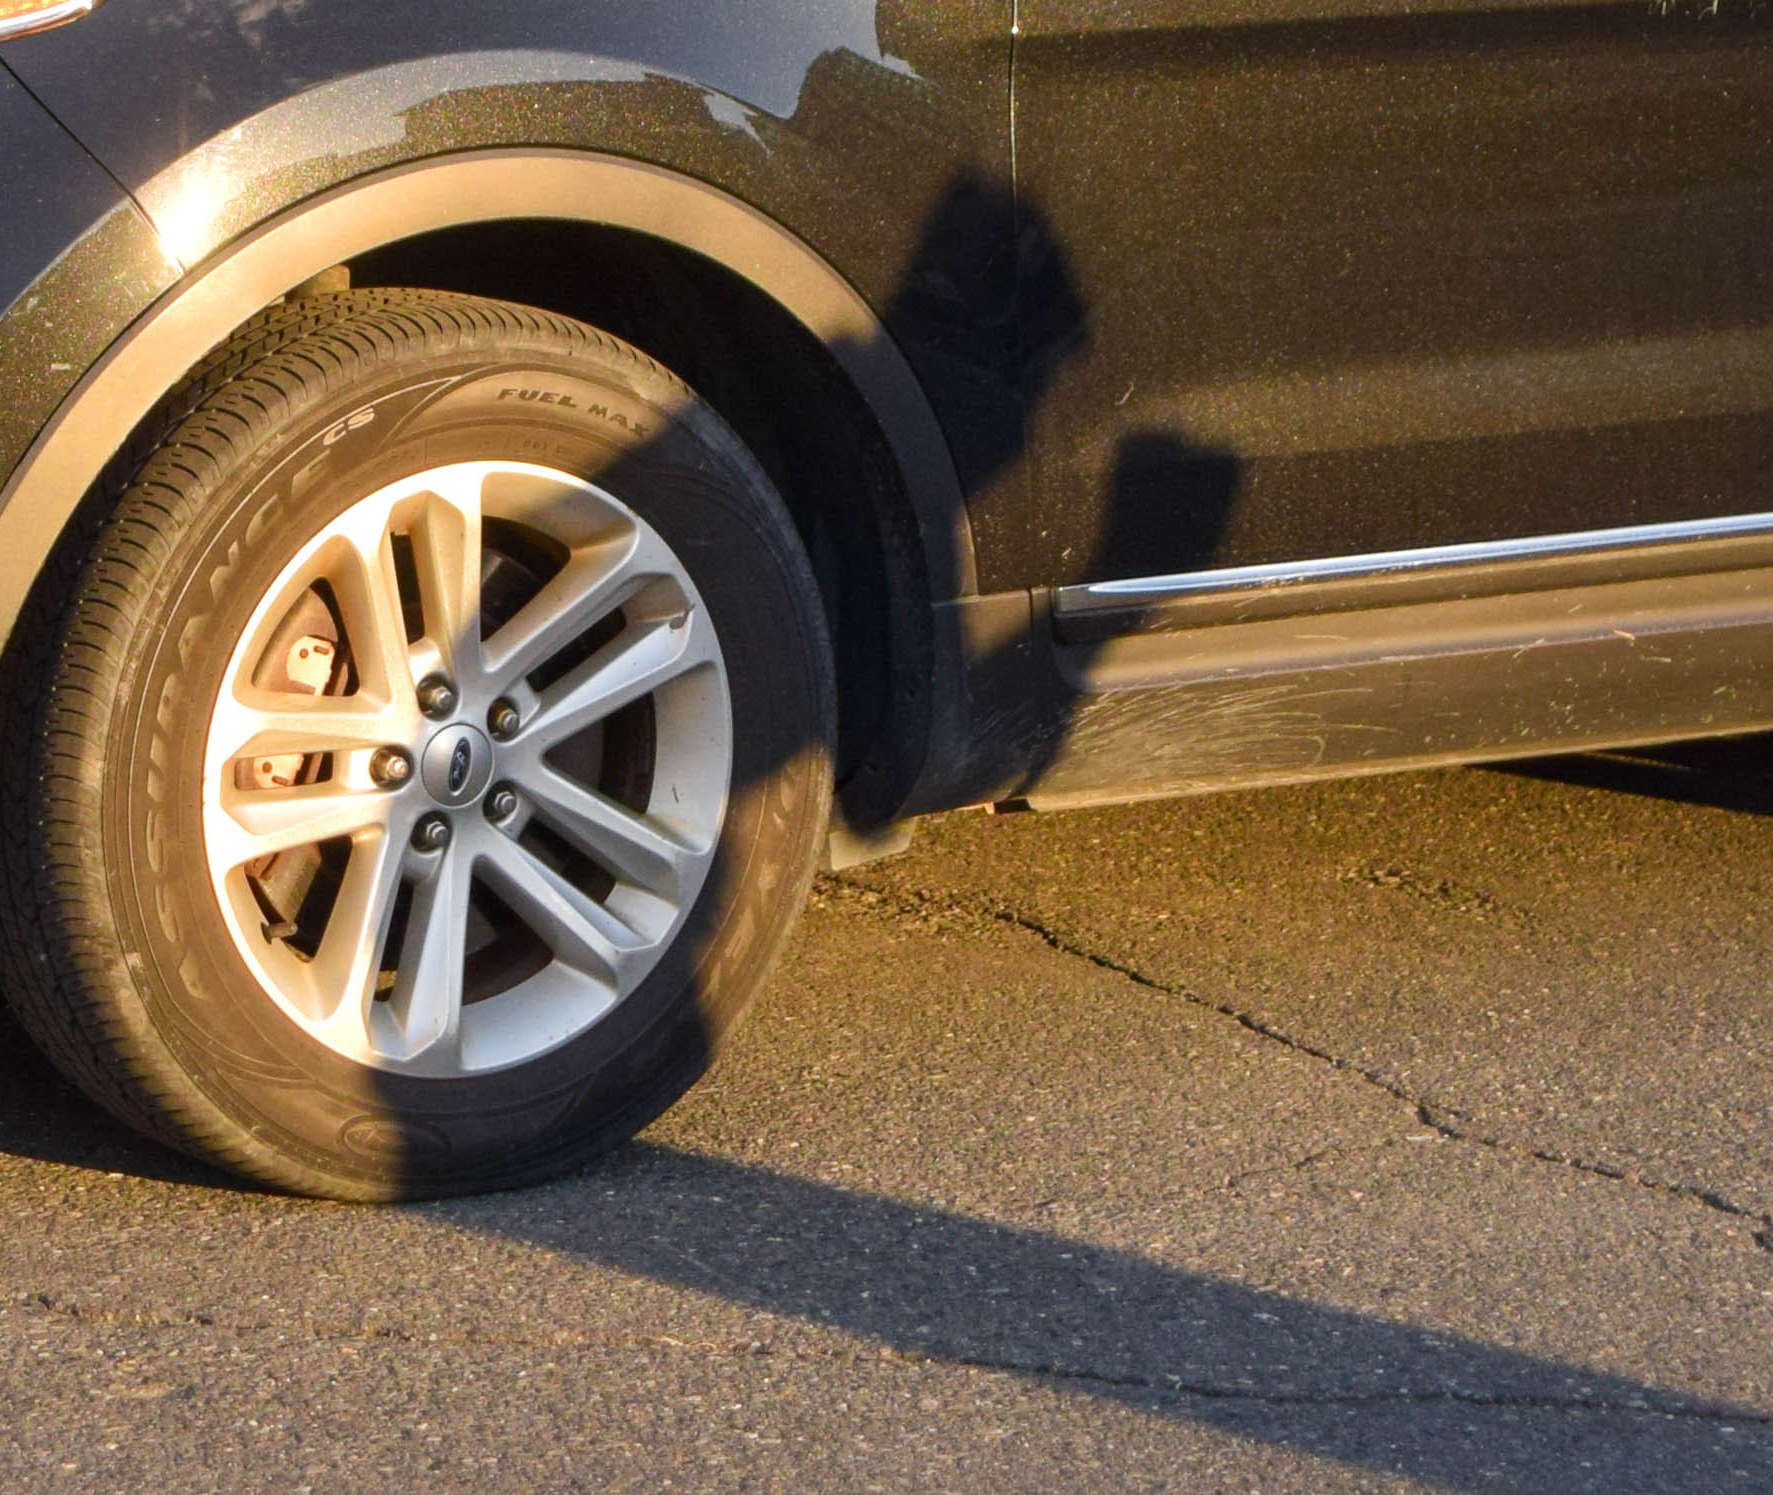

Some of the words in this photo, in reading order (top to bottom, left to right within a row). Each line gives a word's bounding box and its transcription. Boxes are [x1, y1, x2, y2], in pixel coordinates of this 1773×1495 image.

[322, 406, 377, 447] CS
[497, 387, 578, 409] FUEL
[588, 403, 649, 439] MAX
